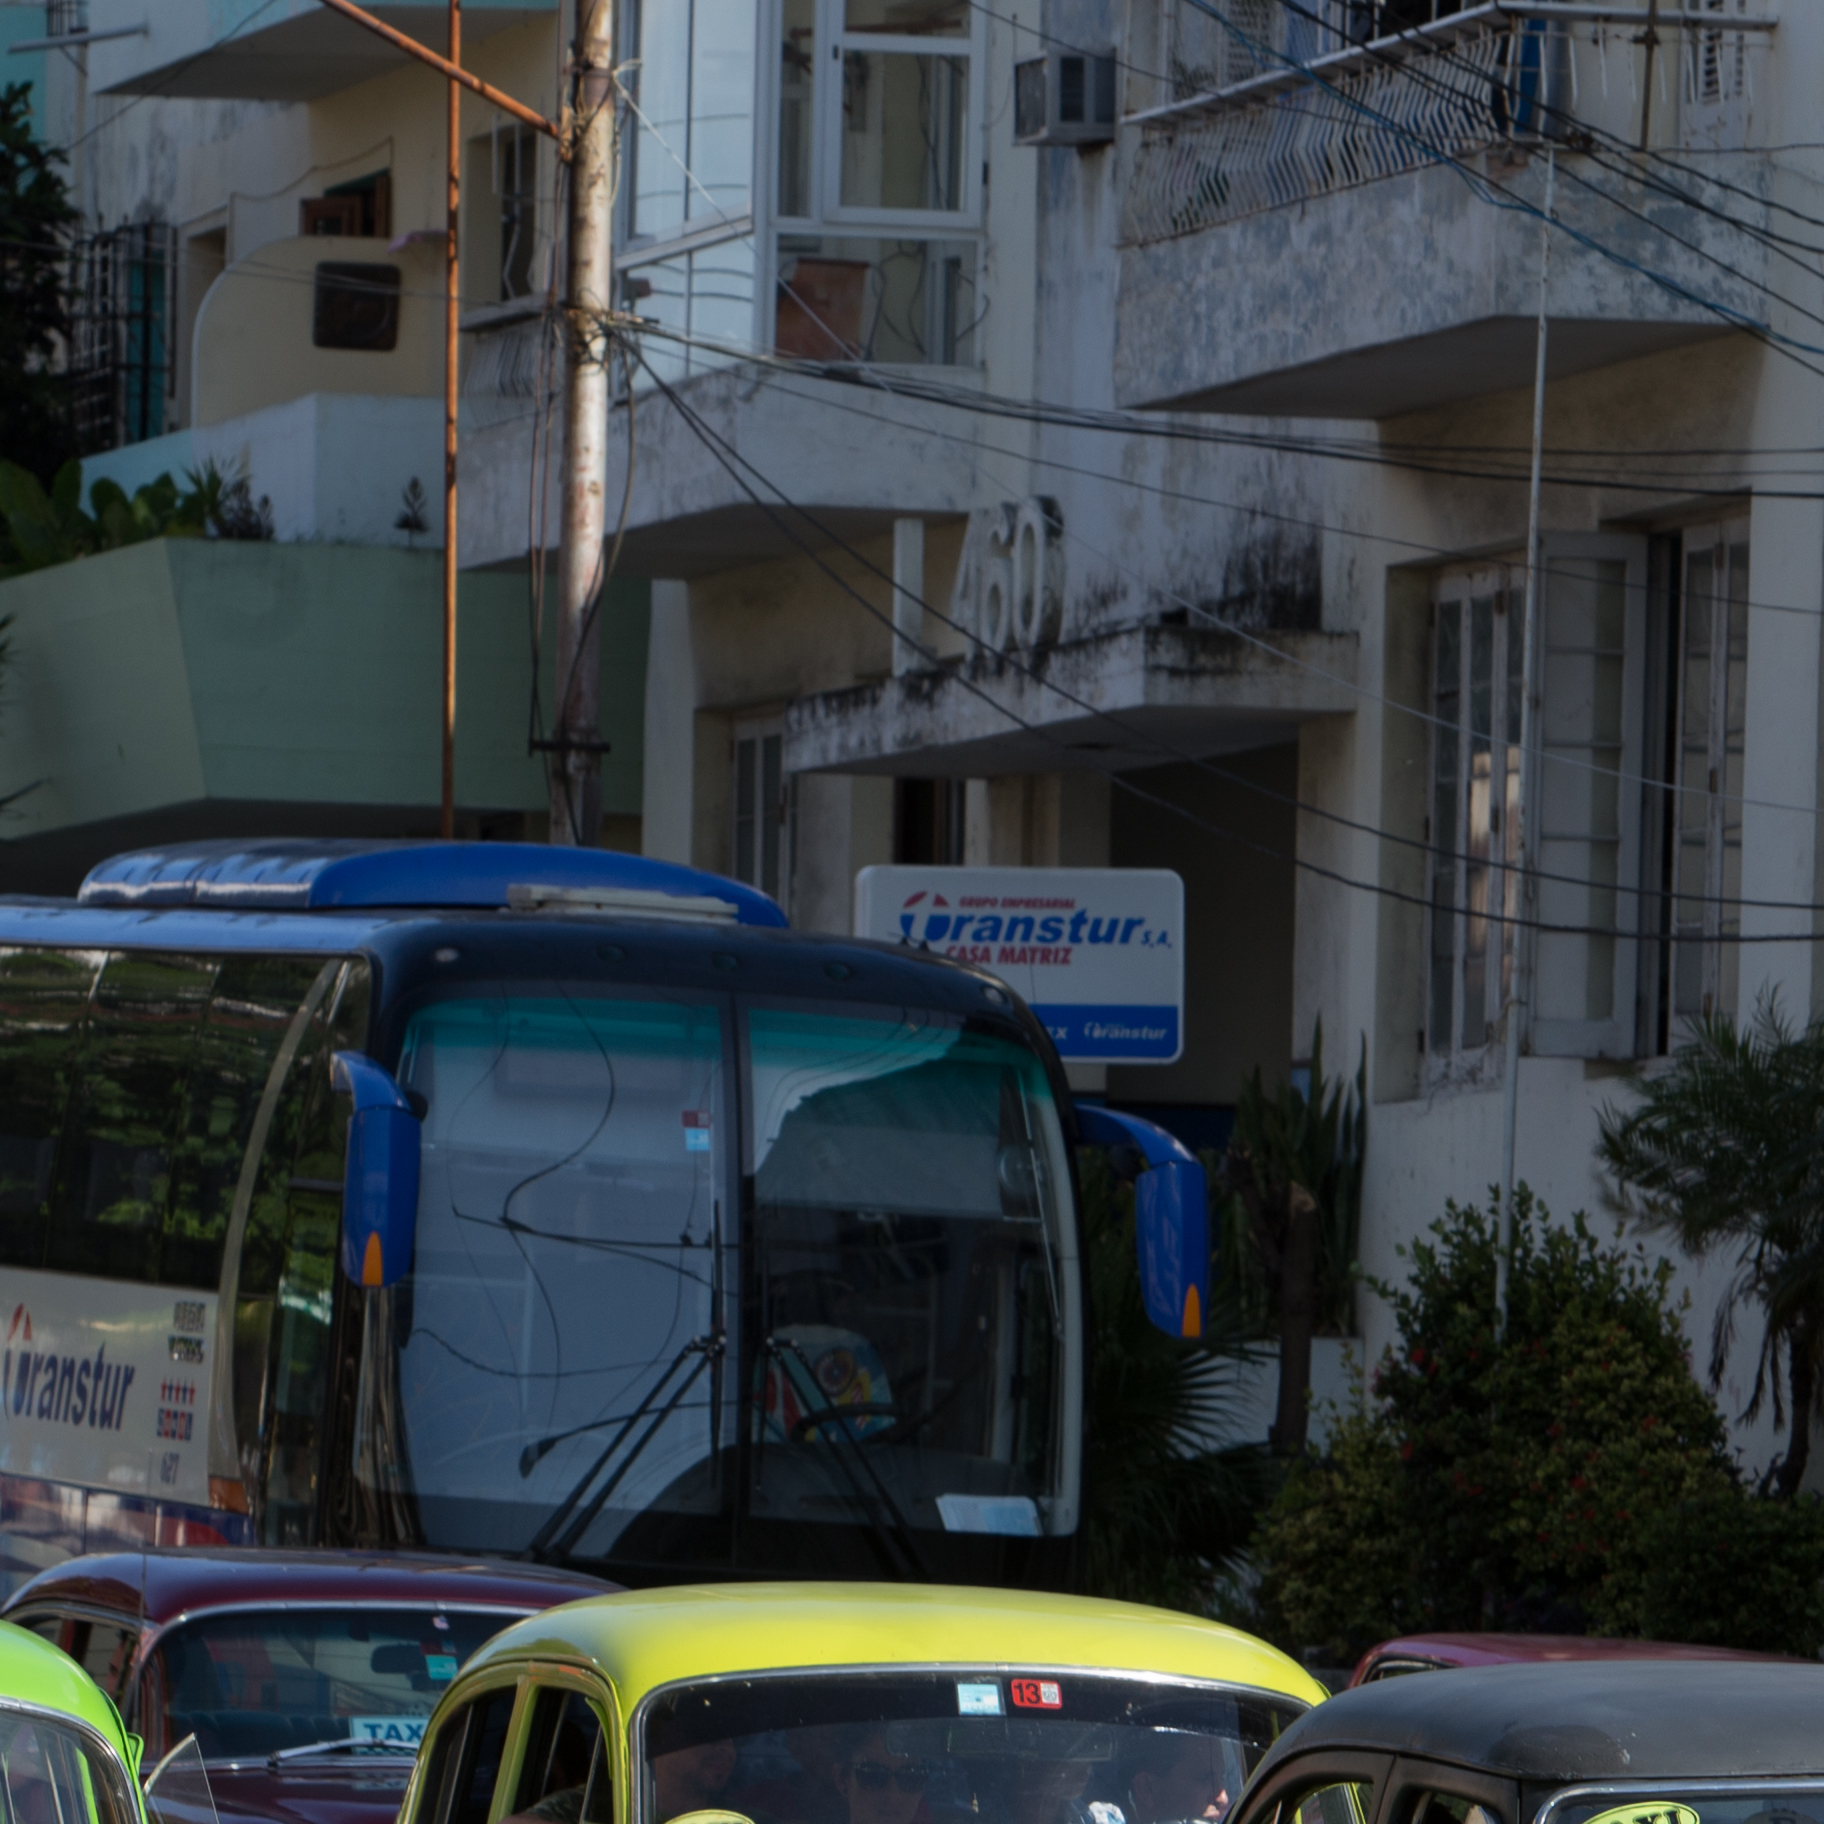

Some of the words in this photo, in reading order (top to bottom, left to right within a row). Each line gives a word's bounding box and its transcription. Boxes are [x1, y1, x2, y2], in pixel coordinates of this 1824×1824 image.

[959, 896, 998, 908] GRUPO
[1142, 929, 1173, 949] S.A.
[997, 946, 1073, 965] MATRIZ
[1013, 1682, 1040, 1704] 13
[363, 1723, 424, 1742] TAX
